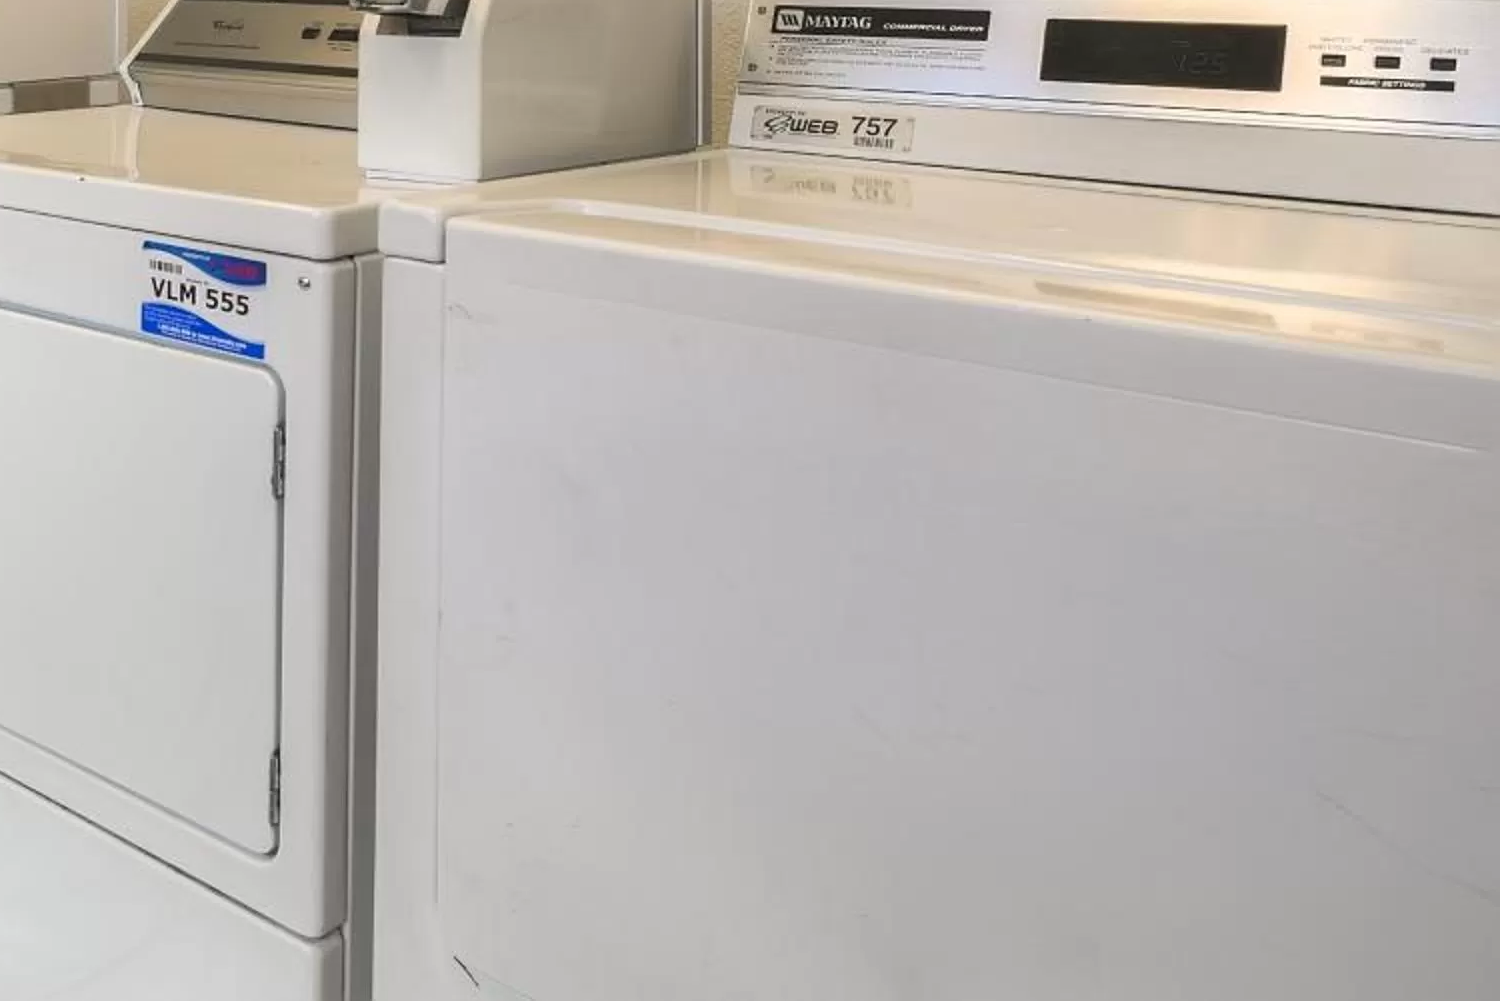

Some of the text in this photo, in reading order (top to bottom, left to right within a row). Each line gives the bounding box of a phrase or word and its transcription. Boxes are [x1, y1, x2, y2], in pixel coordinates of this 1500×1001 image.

[804, 14, 873, 30] MAYTAG
[882, 22, 947, 33] COMMERCIAL
[789, 116, 898, 137] WEB 757
[151, 276, 250, 316] VLM 555
